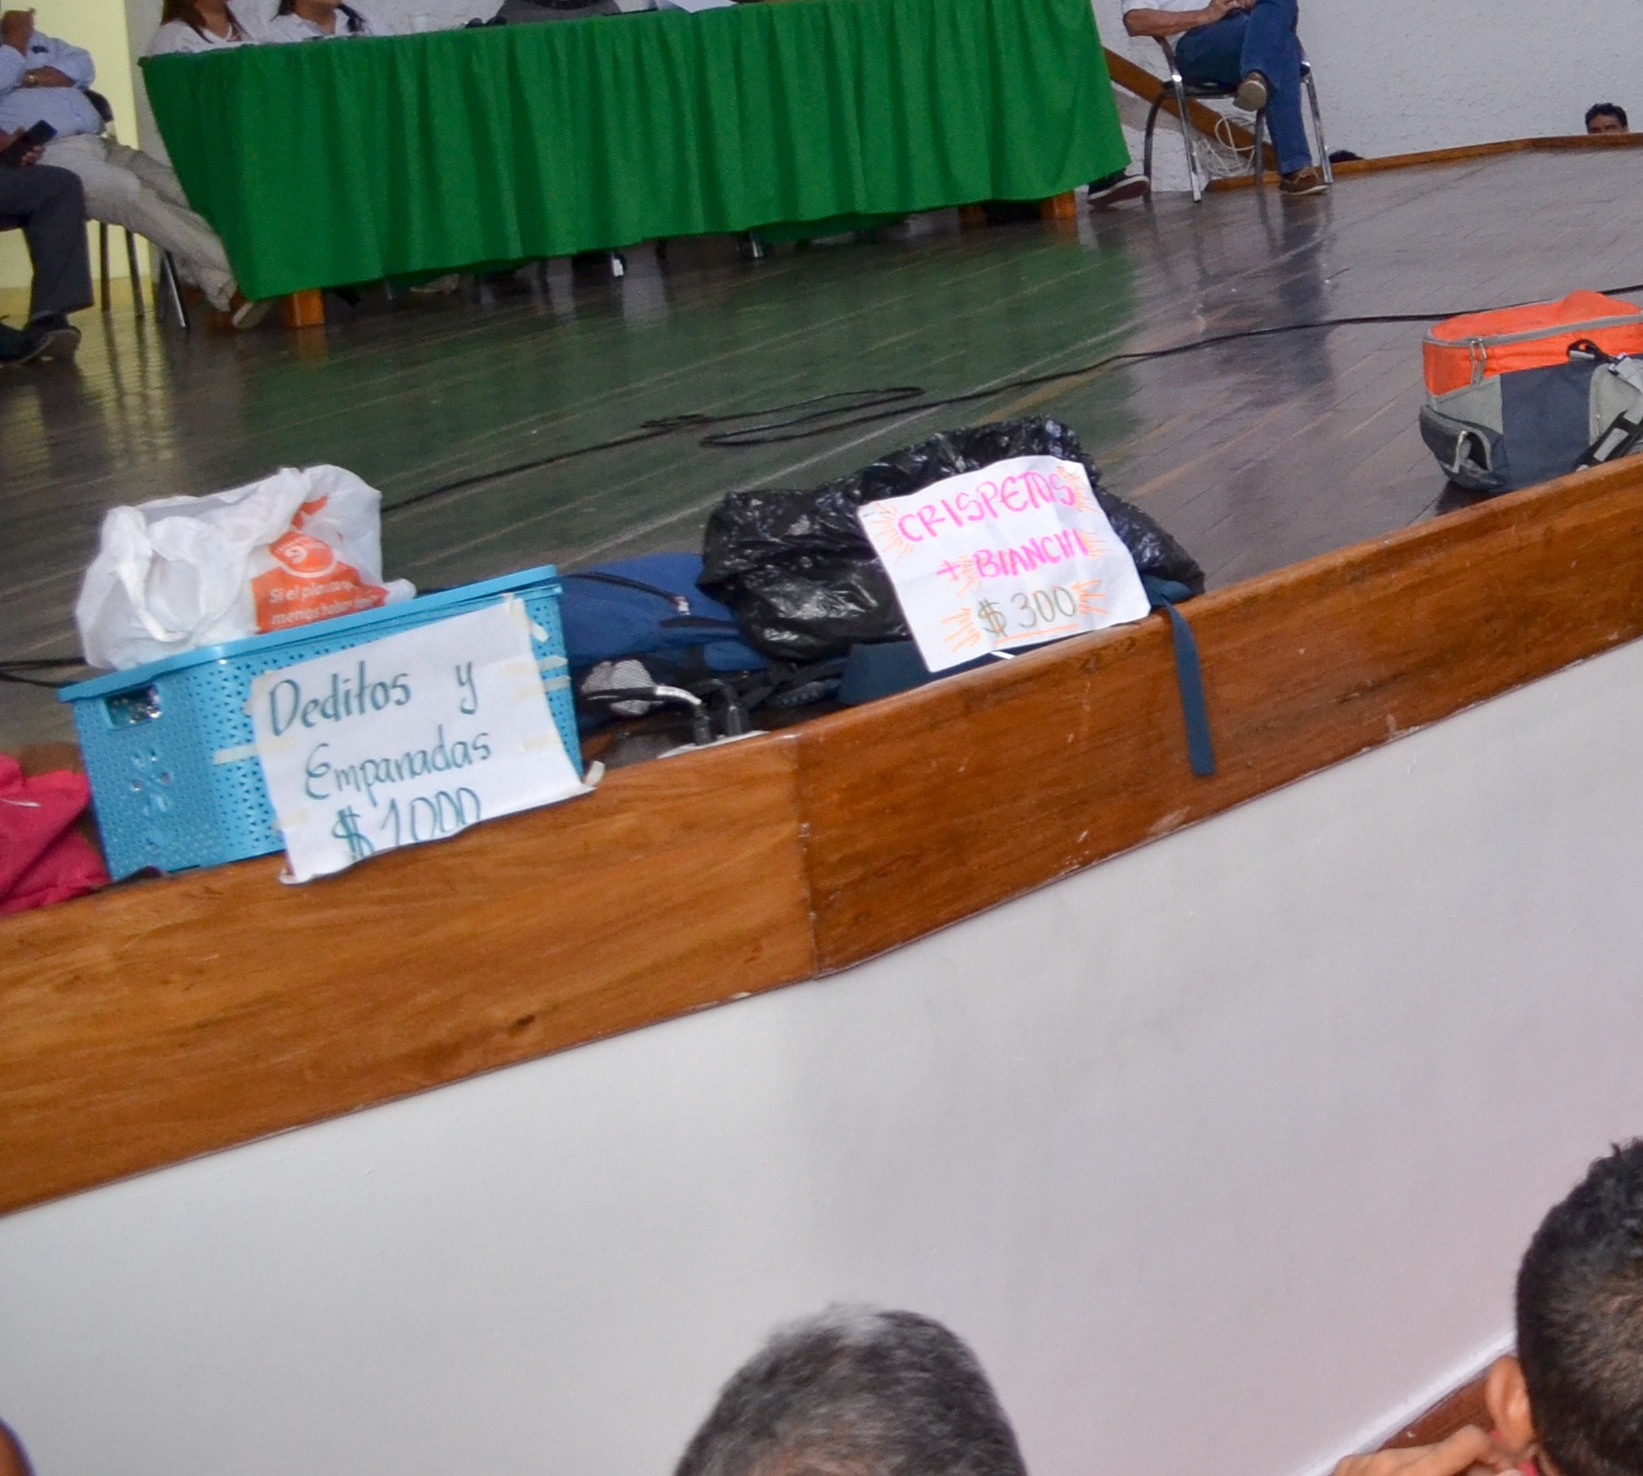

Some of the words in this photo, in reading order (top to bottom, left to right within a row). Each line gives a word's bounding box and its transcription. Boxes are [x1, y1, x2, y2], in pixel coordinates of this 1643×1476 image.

[897, 470, 1077, 543] CRISPETOS
[971, 528, 1089, 579] BIANCHI
[269, 660, 412, 737] Deditos
[455, 660, 478, 715] y
[304, 724, 493, 806] Empanadas
